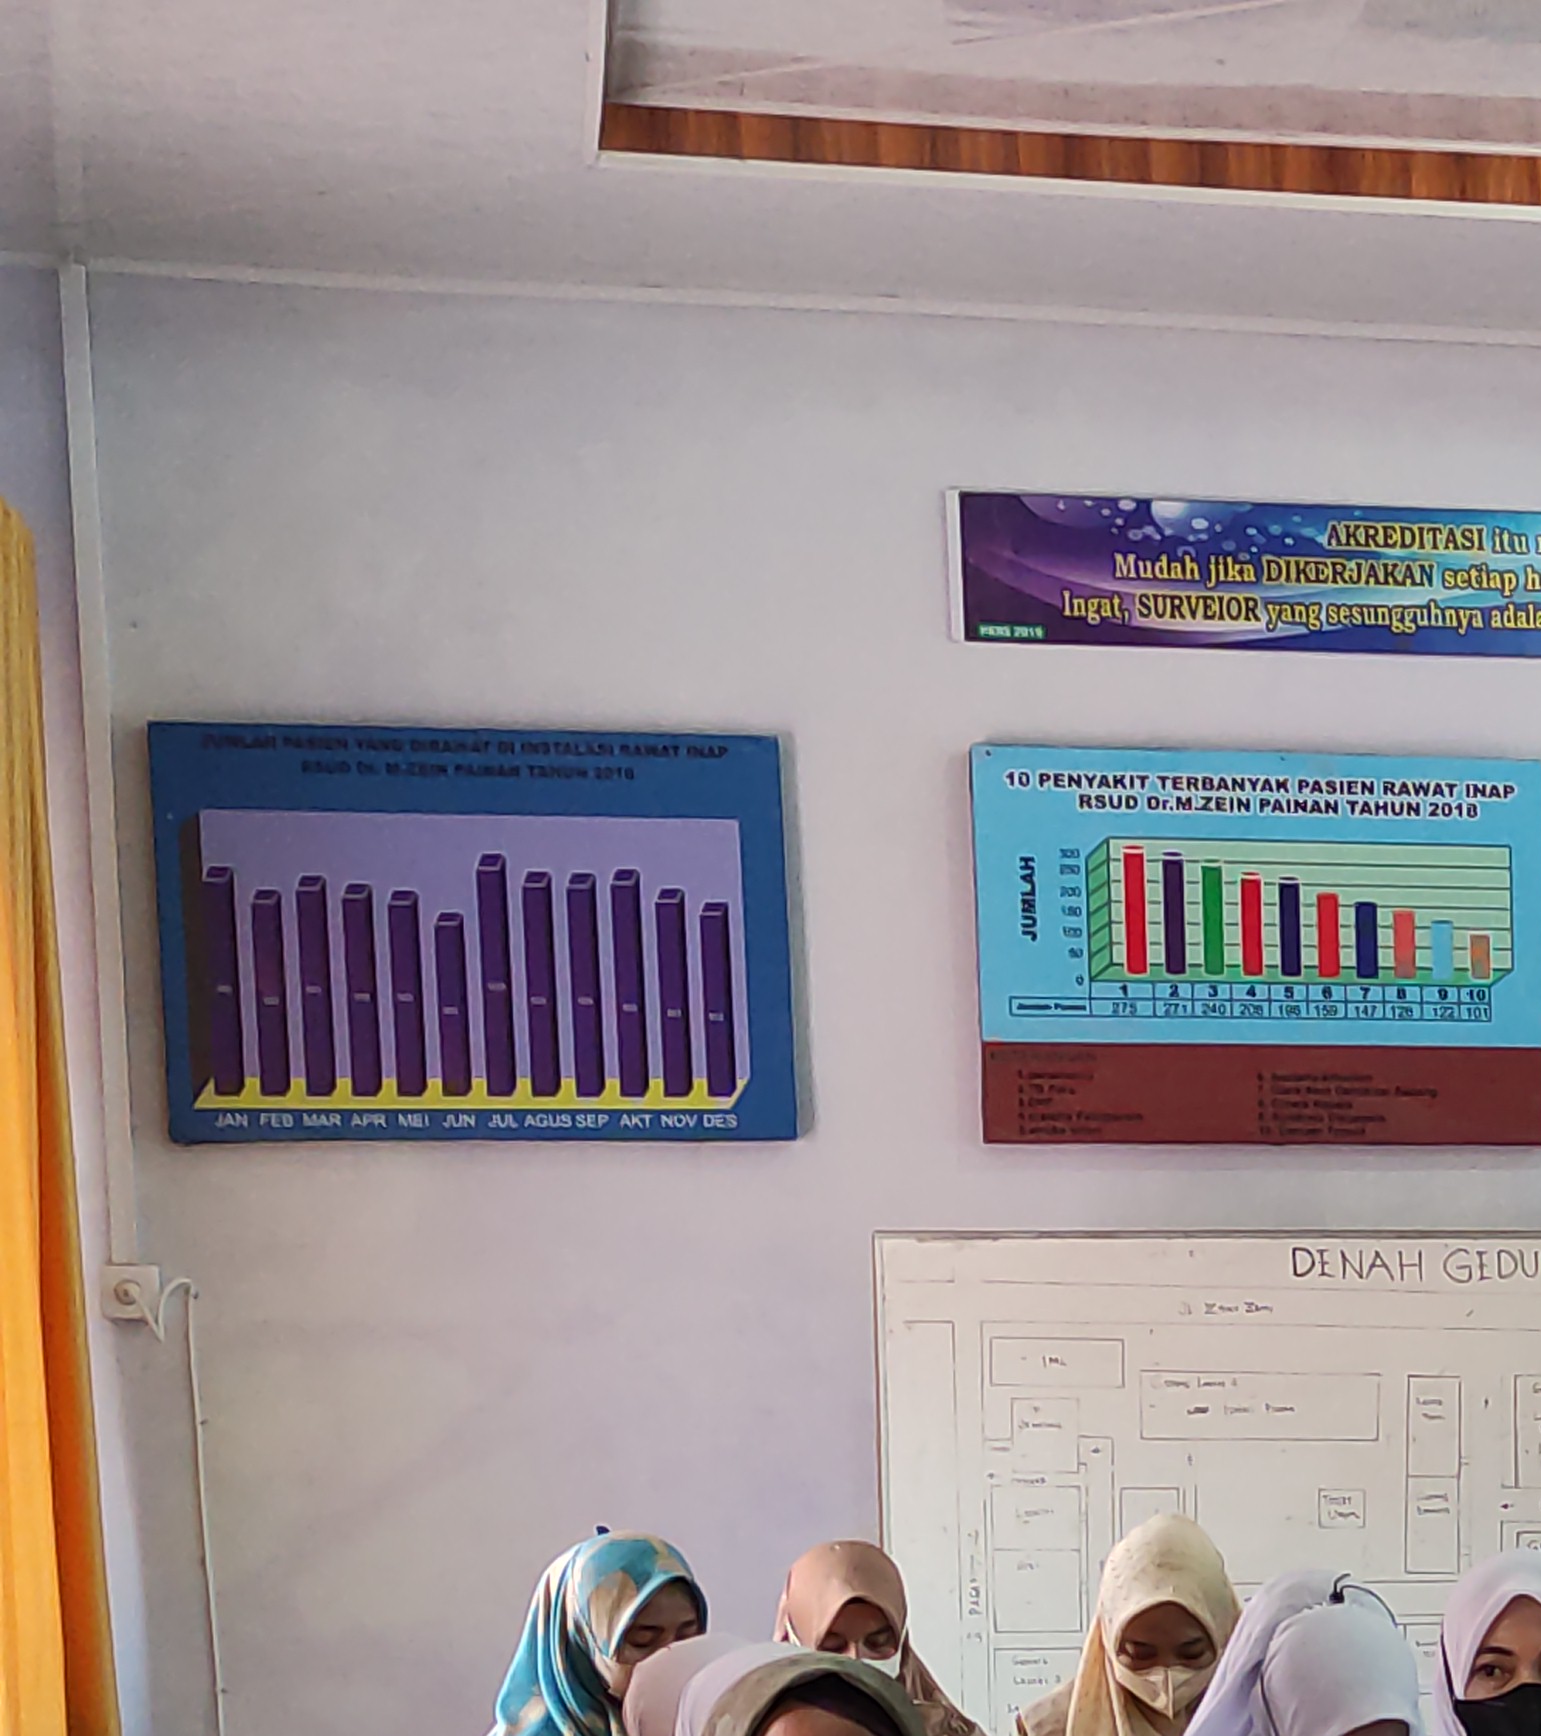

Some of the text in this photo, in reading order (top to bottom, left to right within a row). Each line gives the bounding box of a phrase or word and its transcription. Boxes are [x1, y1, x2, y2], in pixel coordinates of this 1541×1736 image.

[1326, 523, 1486, 552] AKREDITASI
[1492, 527, 1529, 554] itu
[1114, 553, 1200, 580] Mudah
[1206, 555, 1256, 588] jika
[1264, 557, 1435, 587] DIKERJAKAN
[1443, 564, 1518, 596] setiap
[1061, 591, 1130, 624] Ingat,
[1136, 594, 1261, 622] SURVEIOR
[1265, 602, 1322, 632] yang
[1327, 602, 1484, 635] sesungguhnya
[1005, 771, 1515, 800] 10 PENYAKIT TERBANYAK PASIEN RAWAT INAP
[1078, 793, 1138, 810] RSUD
[1258, 798, 1340, 815] PAINAN
[1346, 800, 1421, 817] TAHUN
[1427, 802, 1479, 818] 2018
[1019, 856, 1038, 942] JUMLAH
[214, 1112, 248, 1128] JAN
[302, 1112, 342, 1128] MAR
[351, 1112, 388, 1128] APR
[442, 1112, 476, 1128] JUN
[487, 1113, 519, 1128] JUL
[523, 1113, 573, 1129] AGUS
[575, 1113, 610, 1129] SEP
[660, 1113, 698, 1129] NOV
[703, 1113, 738, 1129] DES
[1291, 1246, 1424, 1283] DENAH
